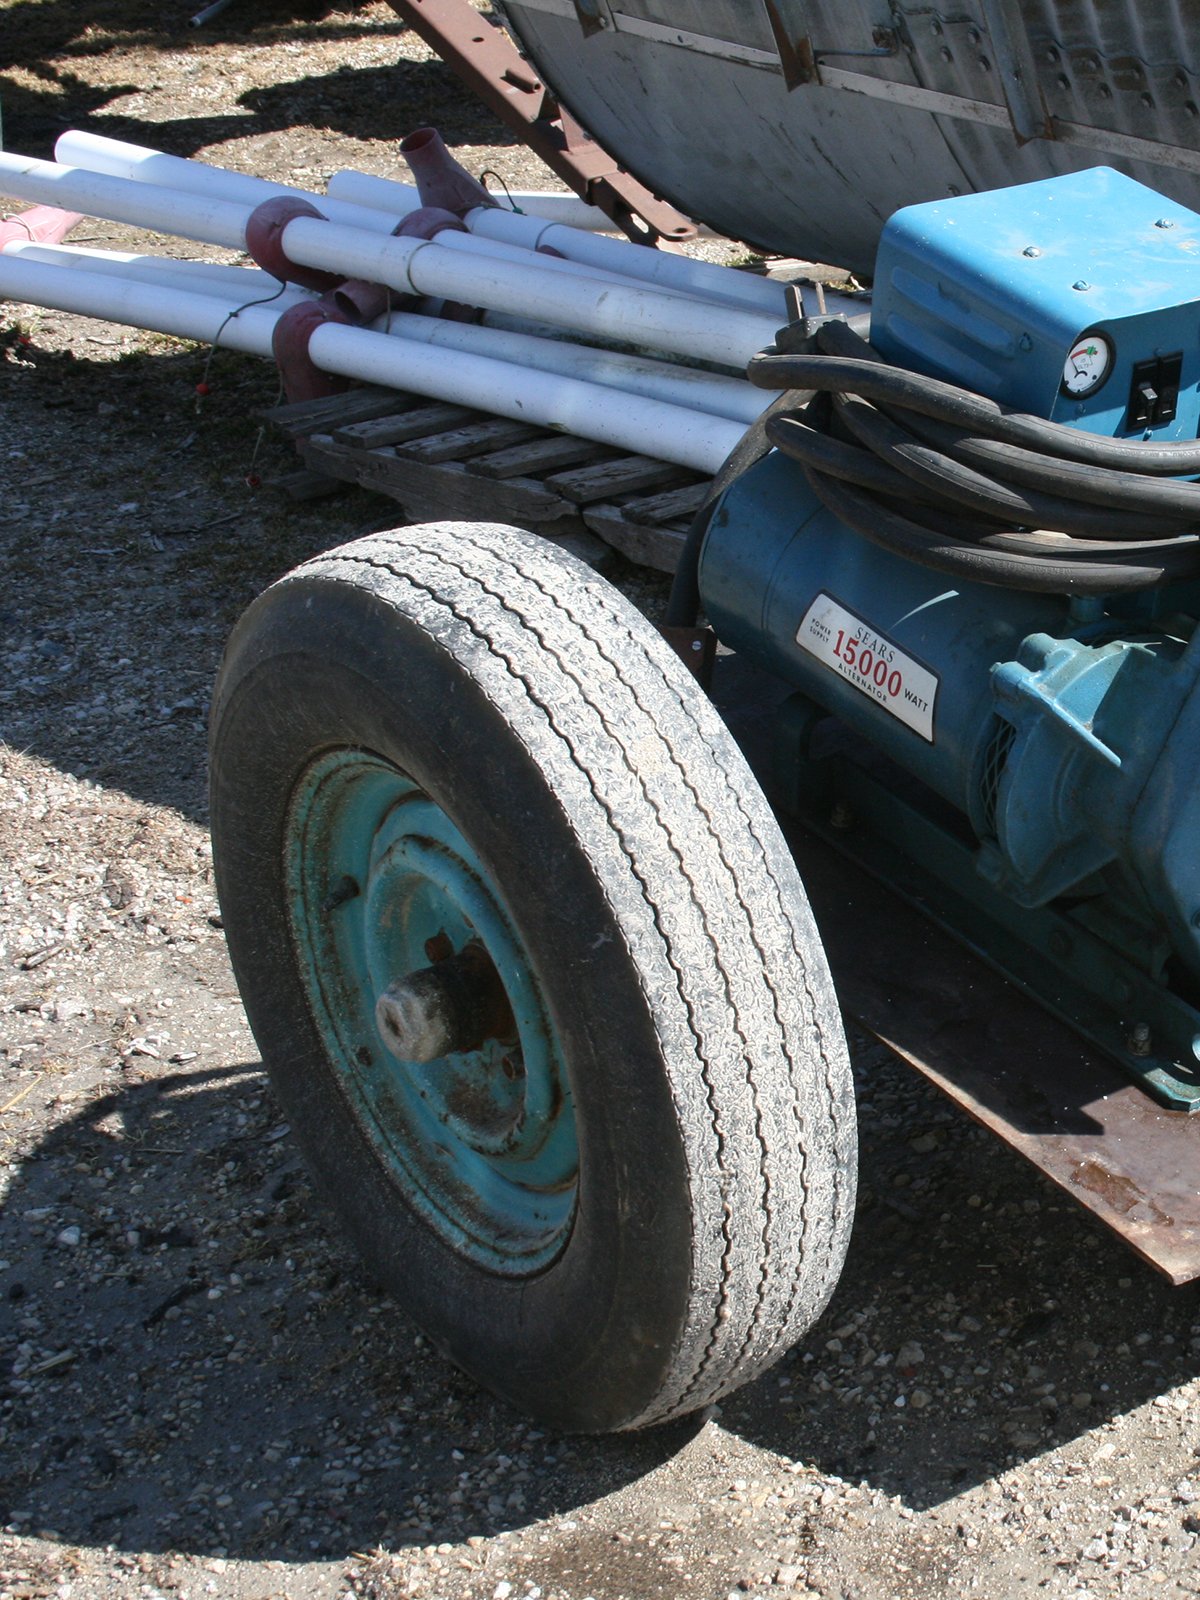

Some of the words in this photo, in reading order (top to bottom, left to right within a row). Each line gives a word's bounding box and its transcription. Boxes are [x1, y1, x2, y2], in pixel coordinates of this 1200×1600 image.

[809, 626, 829, 643] SUPPLY
[811, 618, 831, 635] POWER
[855, 627, 895, 663] SEARS
[838, 663, 887, 703] ALTERNATOR
[904, 688, 928, 712] WATT
